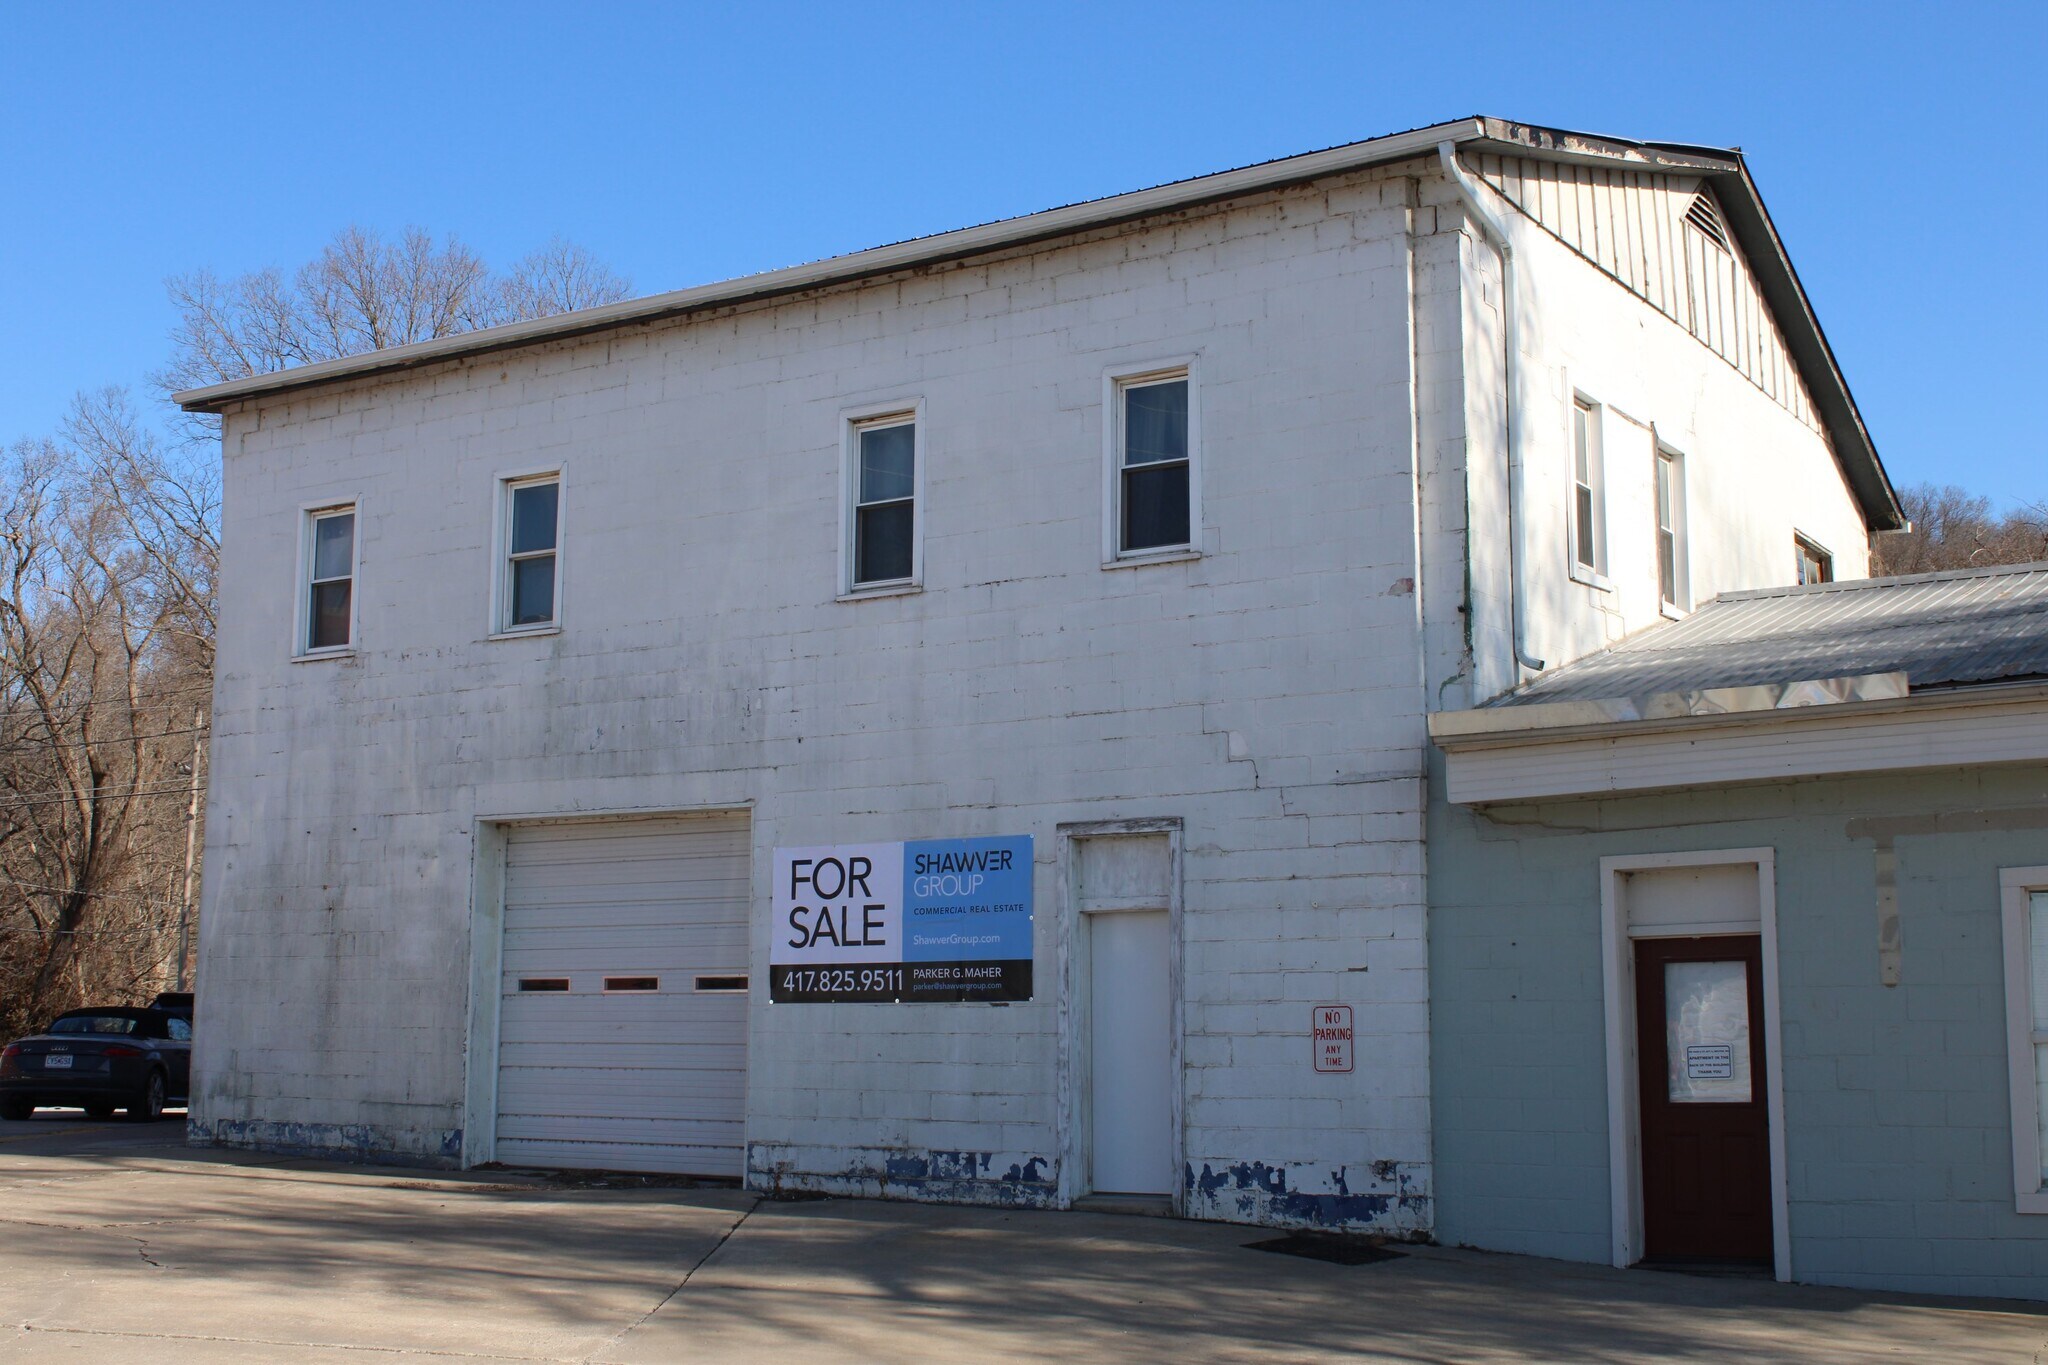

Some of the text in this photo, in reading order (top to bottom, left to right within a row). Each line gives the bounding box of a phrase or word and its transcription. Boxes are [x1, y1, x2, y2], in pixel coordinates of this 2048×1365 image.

[914, 849, 1013, 875] SHAWVER
[790, 856, 872, 900] FOR
[913, 874, 984, 897] GROUP
[913, 903, 1024, 915] COMMERCIAL REAL ESTATE
[788, 904, 886, 949] SALE
[913, 933, 1001, 946] ShawverGroup.com
[913, 968, 950, 979] PARKER
[964, 967, 1002, 978] MAHER
[783, 969, 903, 992] 417.825.9511
[913, 981, 1002, 992] parker@shawvergroup.com
[1325, 1011, 1341, 1024] NO
[1316, 1028, 1351, 1040] PARKING
[1325, 1046, 1341, 1054] ANY
[1325, 1058, 1342, 1066] TIME
